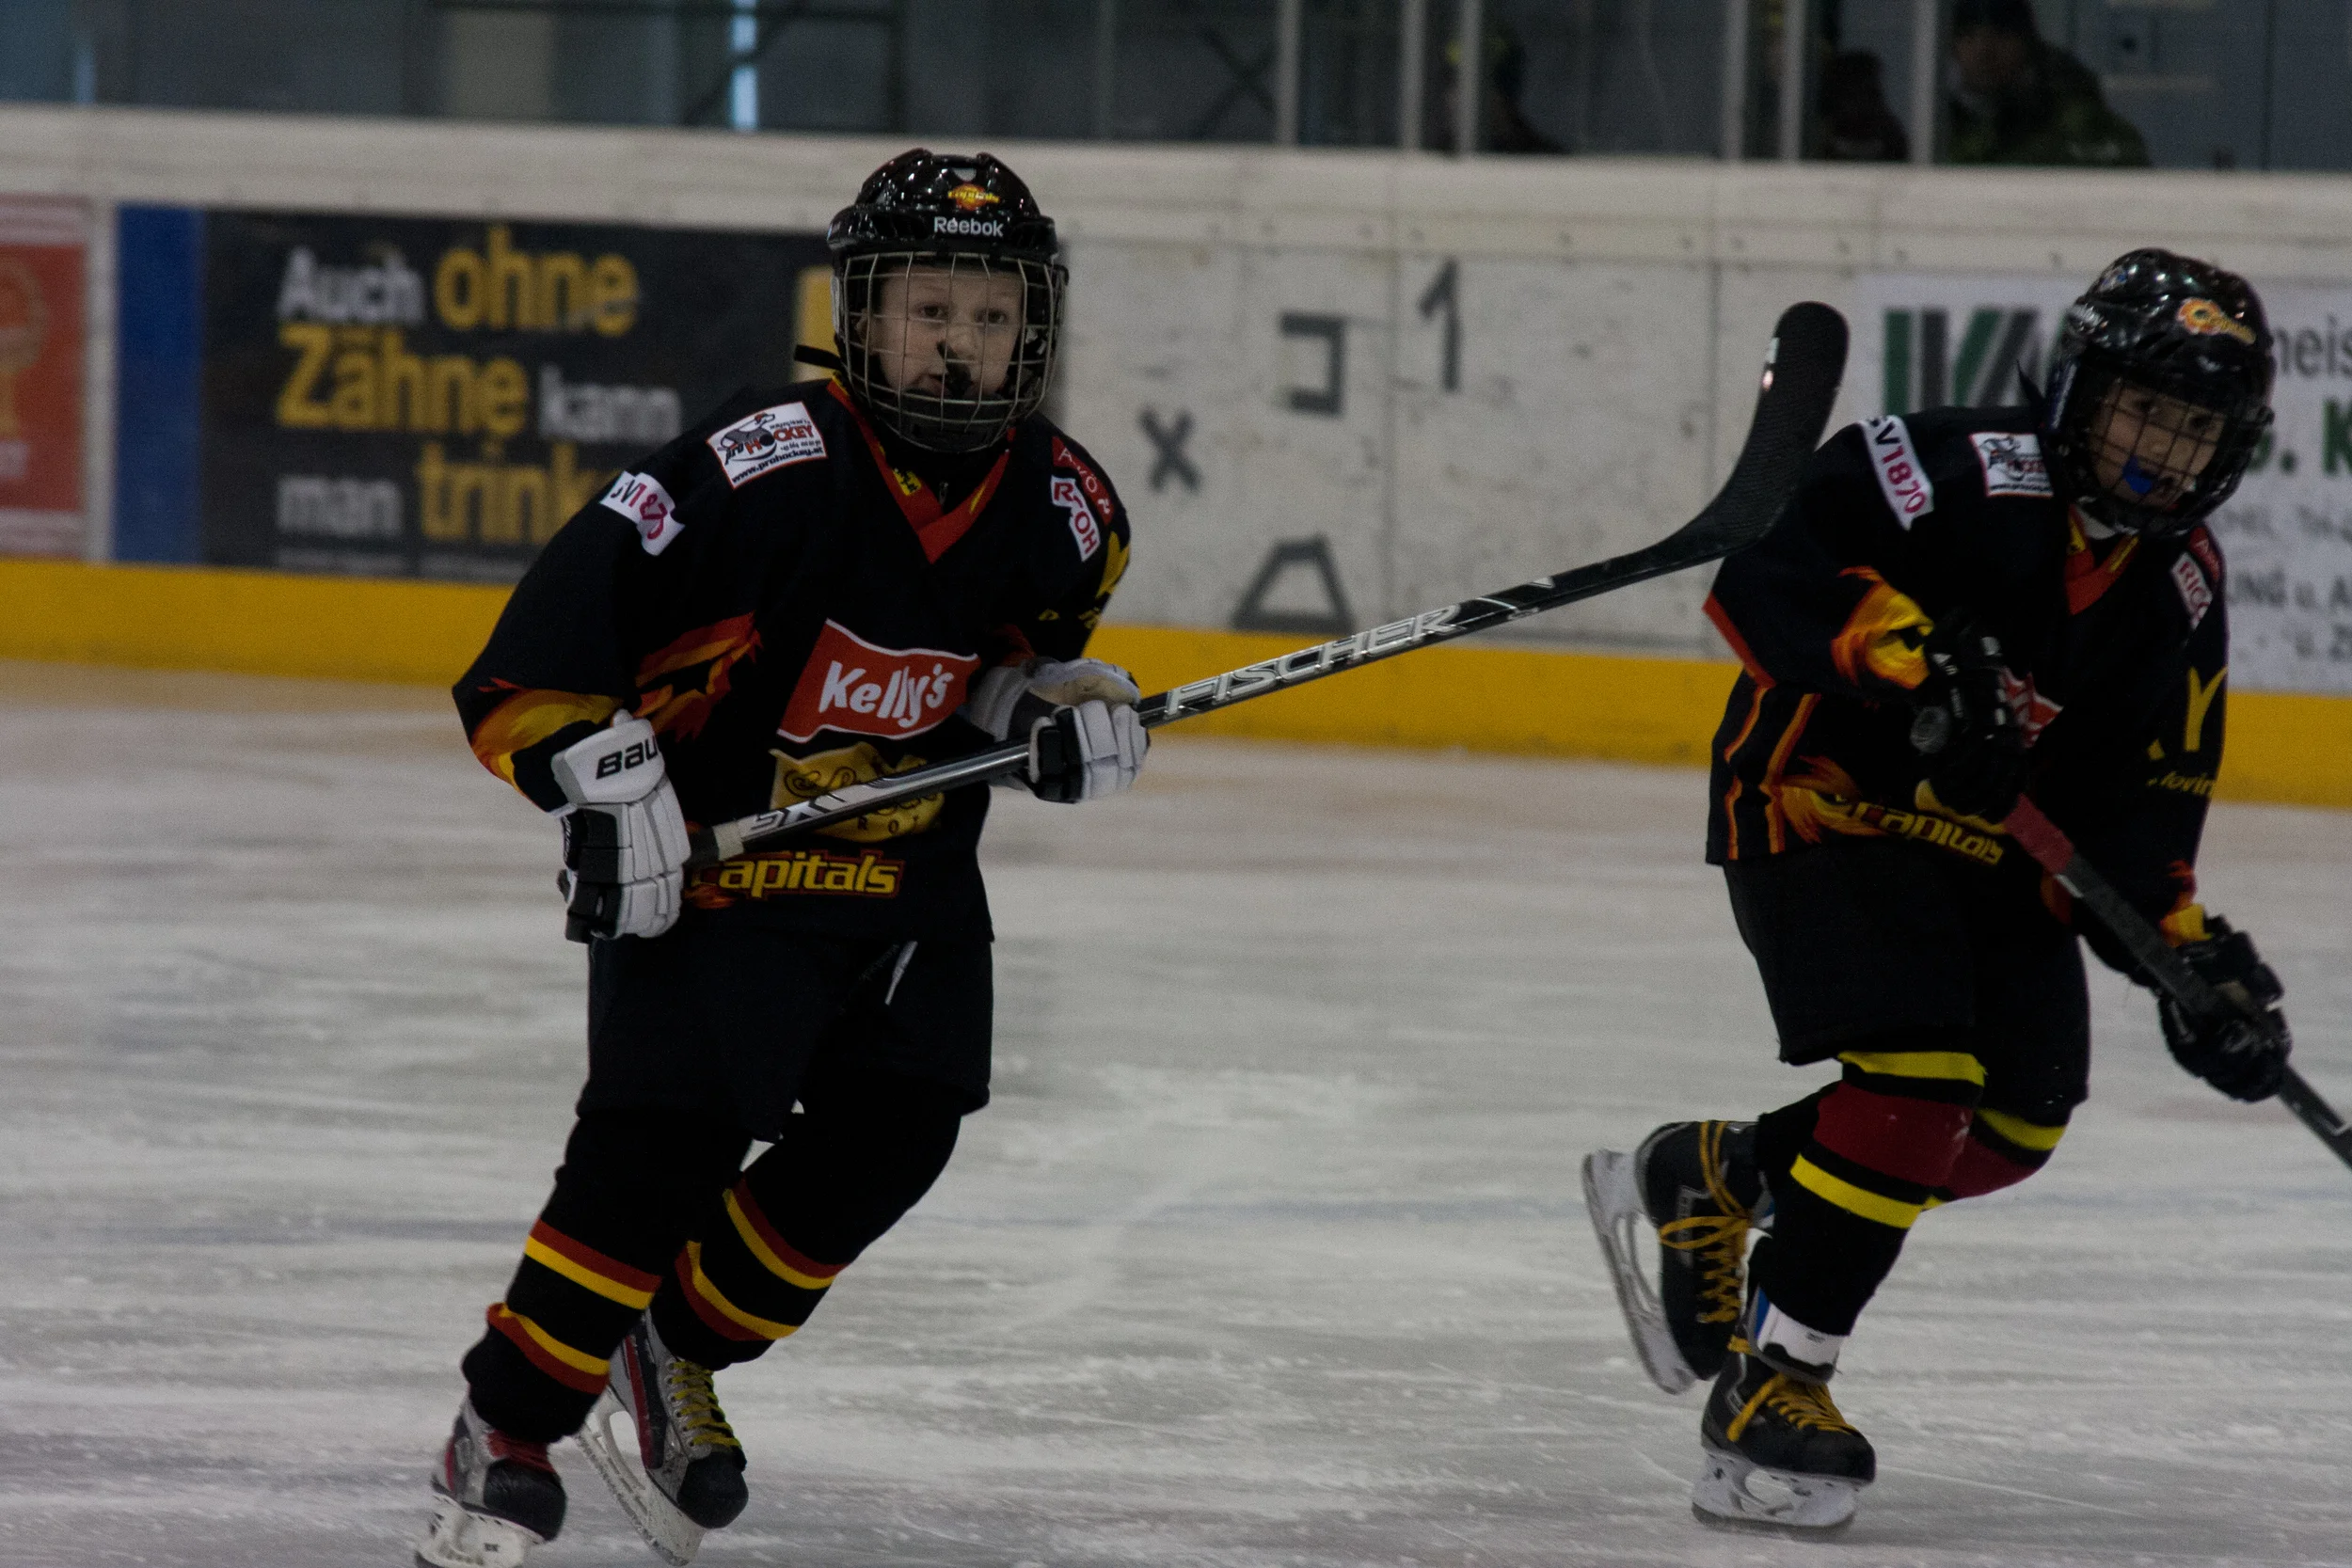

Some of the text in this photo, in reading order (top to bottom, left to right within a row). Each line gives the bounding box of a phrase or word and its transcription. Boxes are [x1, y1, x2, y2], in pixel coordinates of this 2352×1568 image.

[933, 215, 1004, 238] Reebok
[278, 224, 641, 337] Auch ohne
[277, 320, 684, 443] Zähne kann
[731, 447, 824, 483] www.prohockey.at
[744, 424, 815, 455] HOCKEY
[278, 475, 403, 537] man
[818, 659, 955, 729] Kelly's
[1164, 604, 1465, 721] FISCHER
